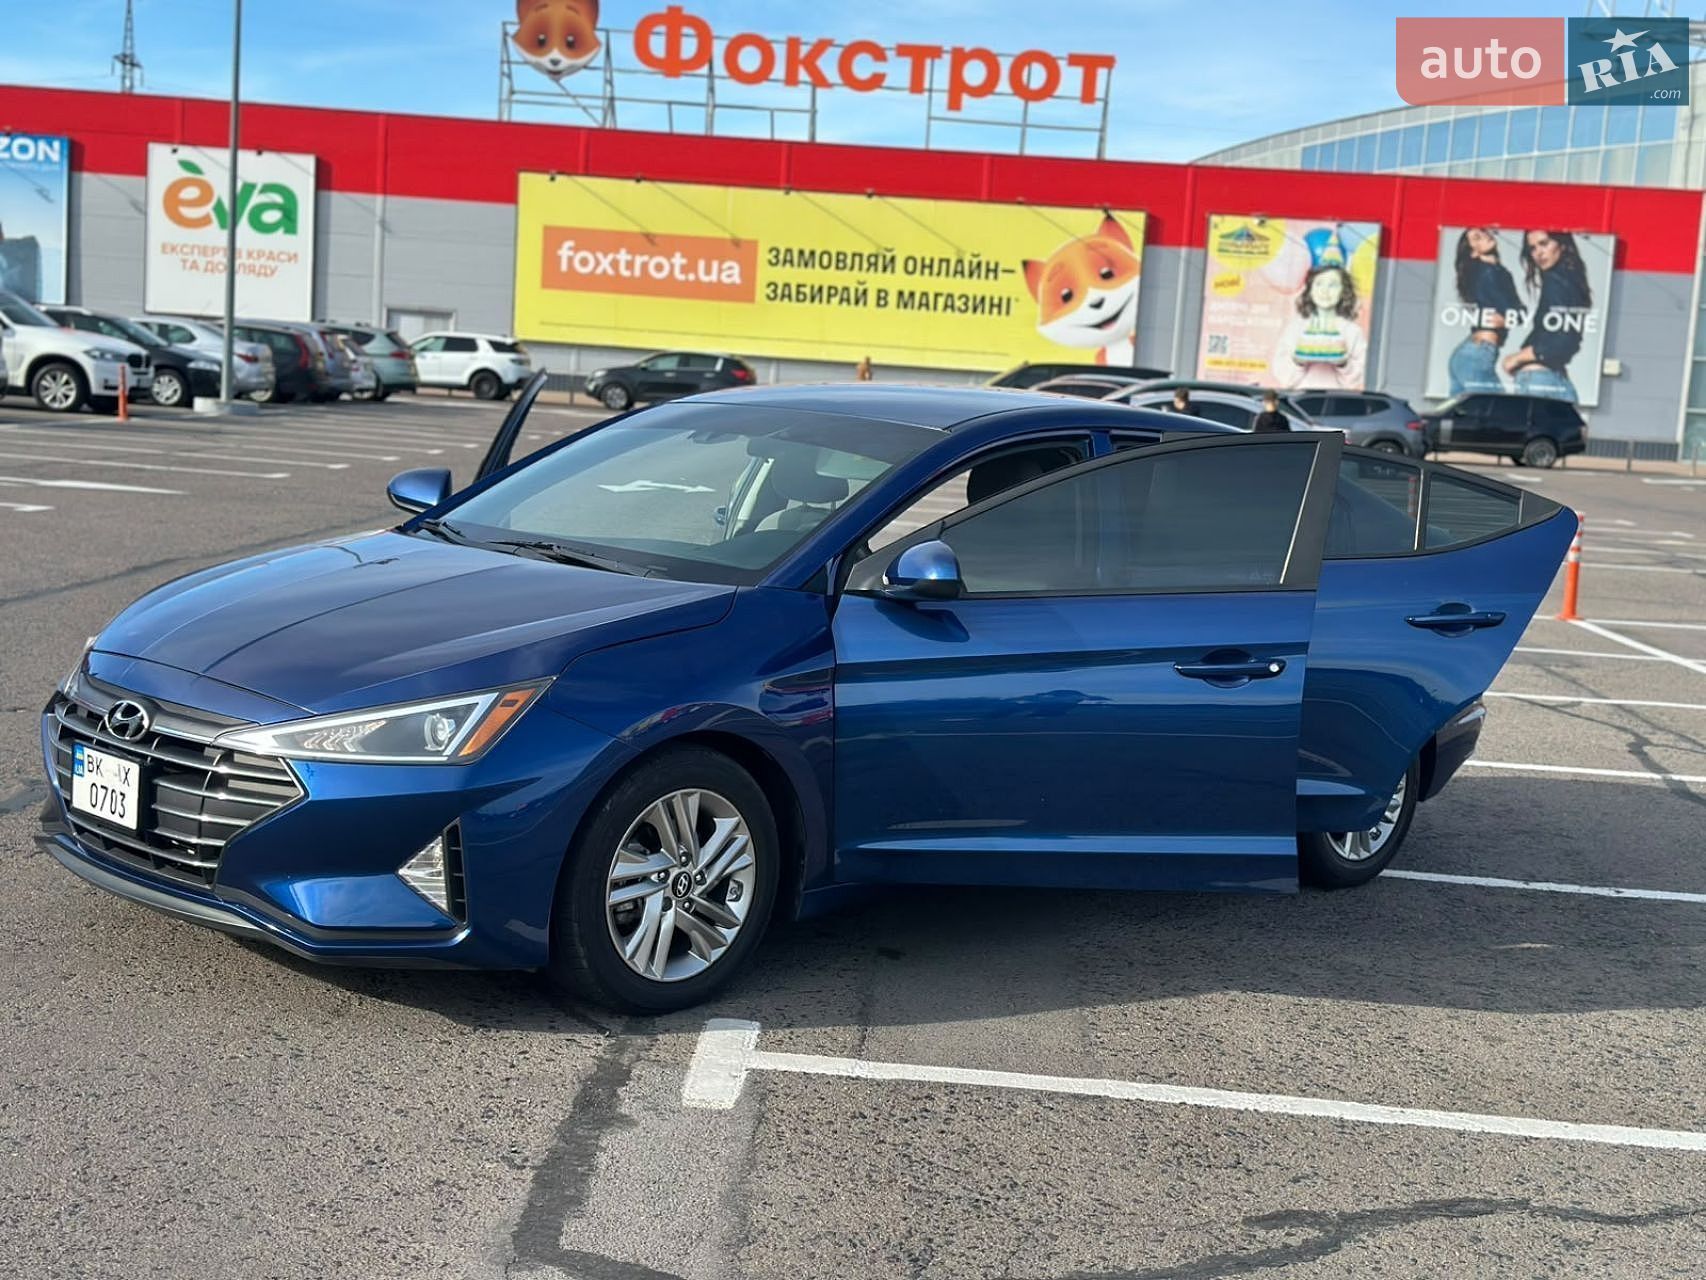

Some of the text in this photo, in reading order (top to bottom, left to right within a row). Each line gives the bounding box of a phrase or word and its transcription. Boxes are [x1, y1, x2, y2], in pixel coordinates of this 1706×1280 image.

[633, 5, 1116, 111] Фокстрот
[204, 260, 278, 278] ДОЛЯДУ
[557, 240, 742, 284] foxtrot.ua
[767, 247, 896, 275] ЗАМОВЛЯЙ
[765, 280, 868, 307] ЗАБИРАЙ
[875, 288, 889, 309] В
[1440, 306, 1599, 333] ONE BY ONE
[90, 782, 126, 819] 0703
